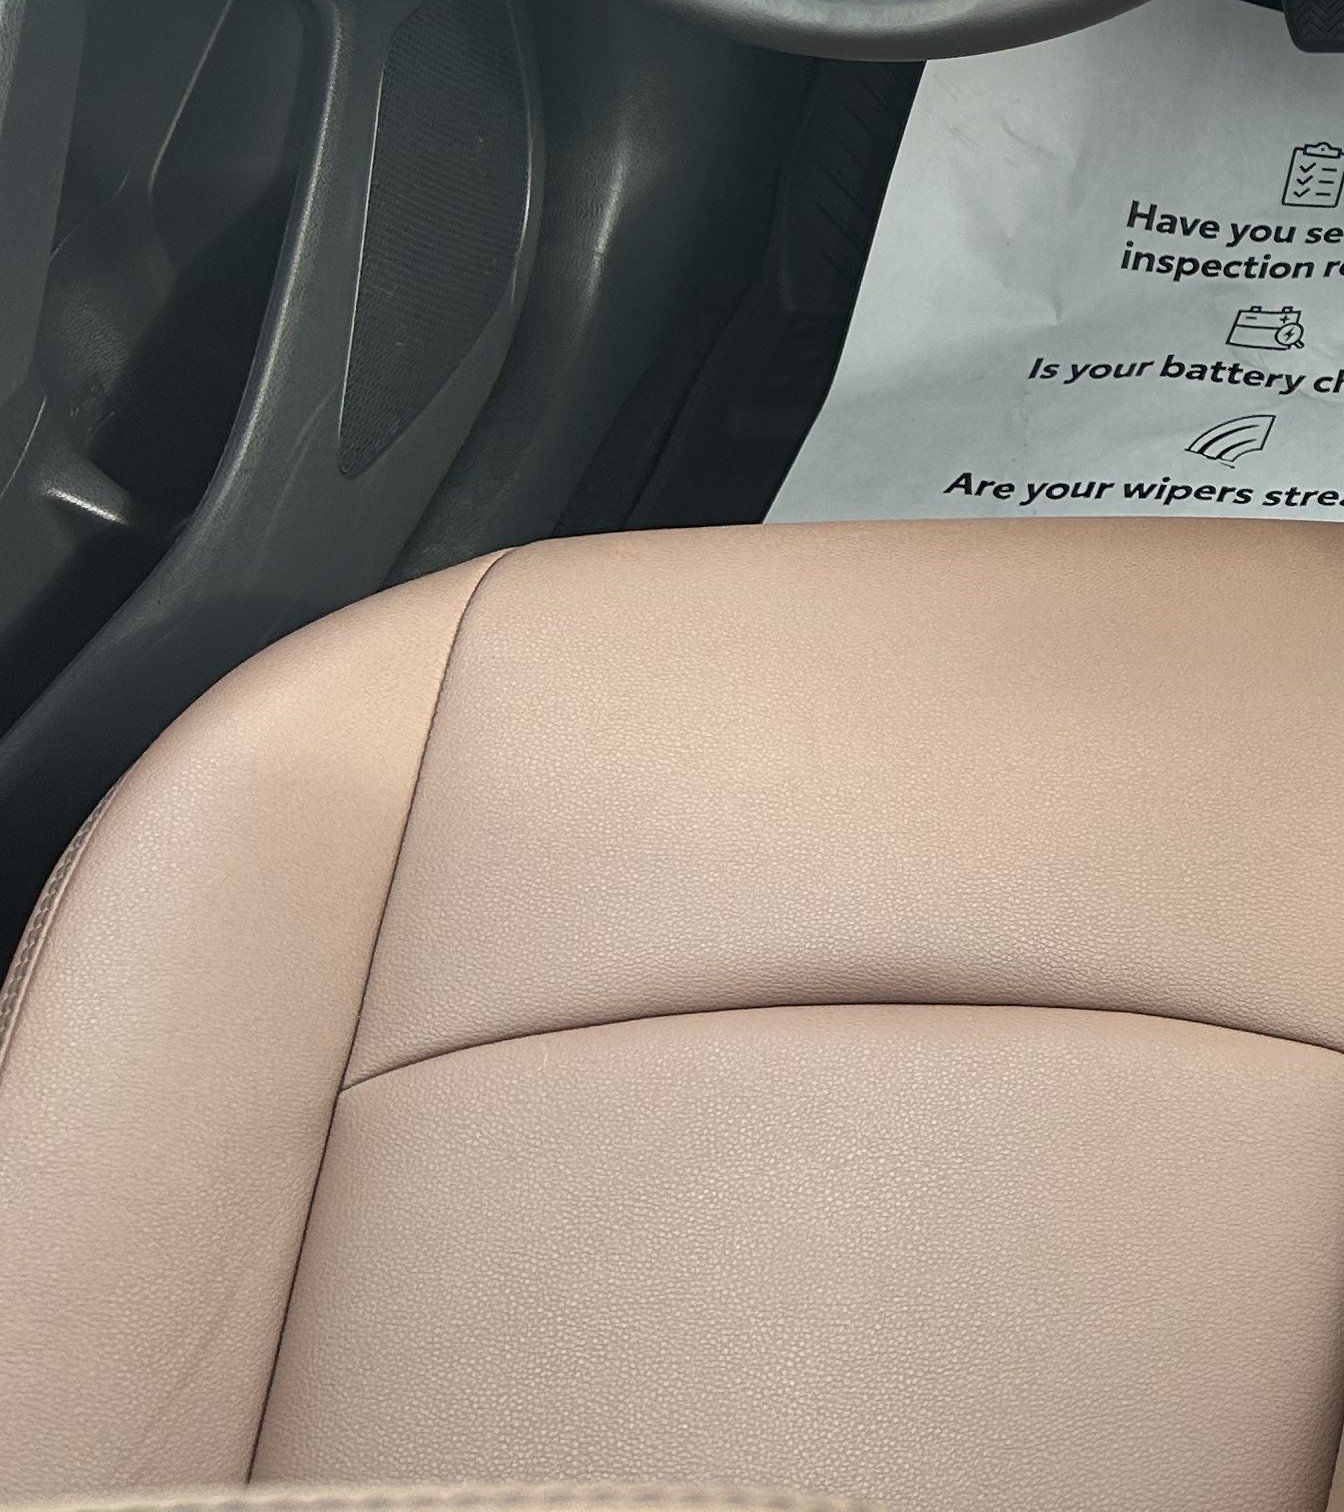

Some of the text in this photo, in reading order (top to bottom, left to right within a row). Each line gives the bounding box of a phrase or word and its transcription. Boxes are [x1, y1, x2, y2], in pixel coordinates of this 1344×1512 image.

[1126, 200, 1220, 239] Have
[1225, 223, 1297, 248] you
[1120, 240, 1315, 282] inspection
[1028, 357, 1060, 380] Is
[1063, 360, 1155, 385] your
[1159, 354, 1306, 393] battery
[943, 472, 1015, 501] Are
[1020, 481, 1115, 506] your
[1123, 476, 1254, 506] wipers
